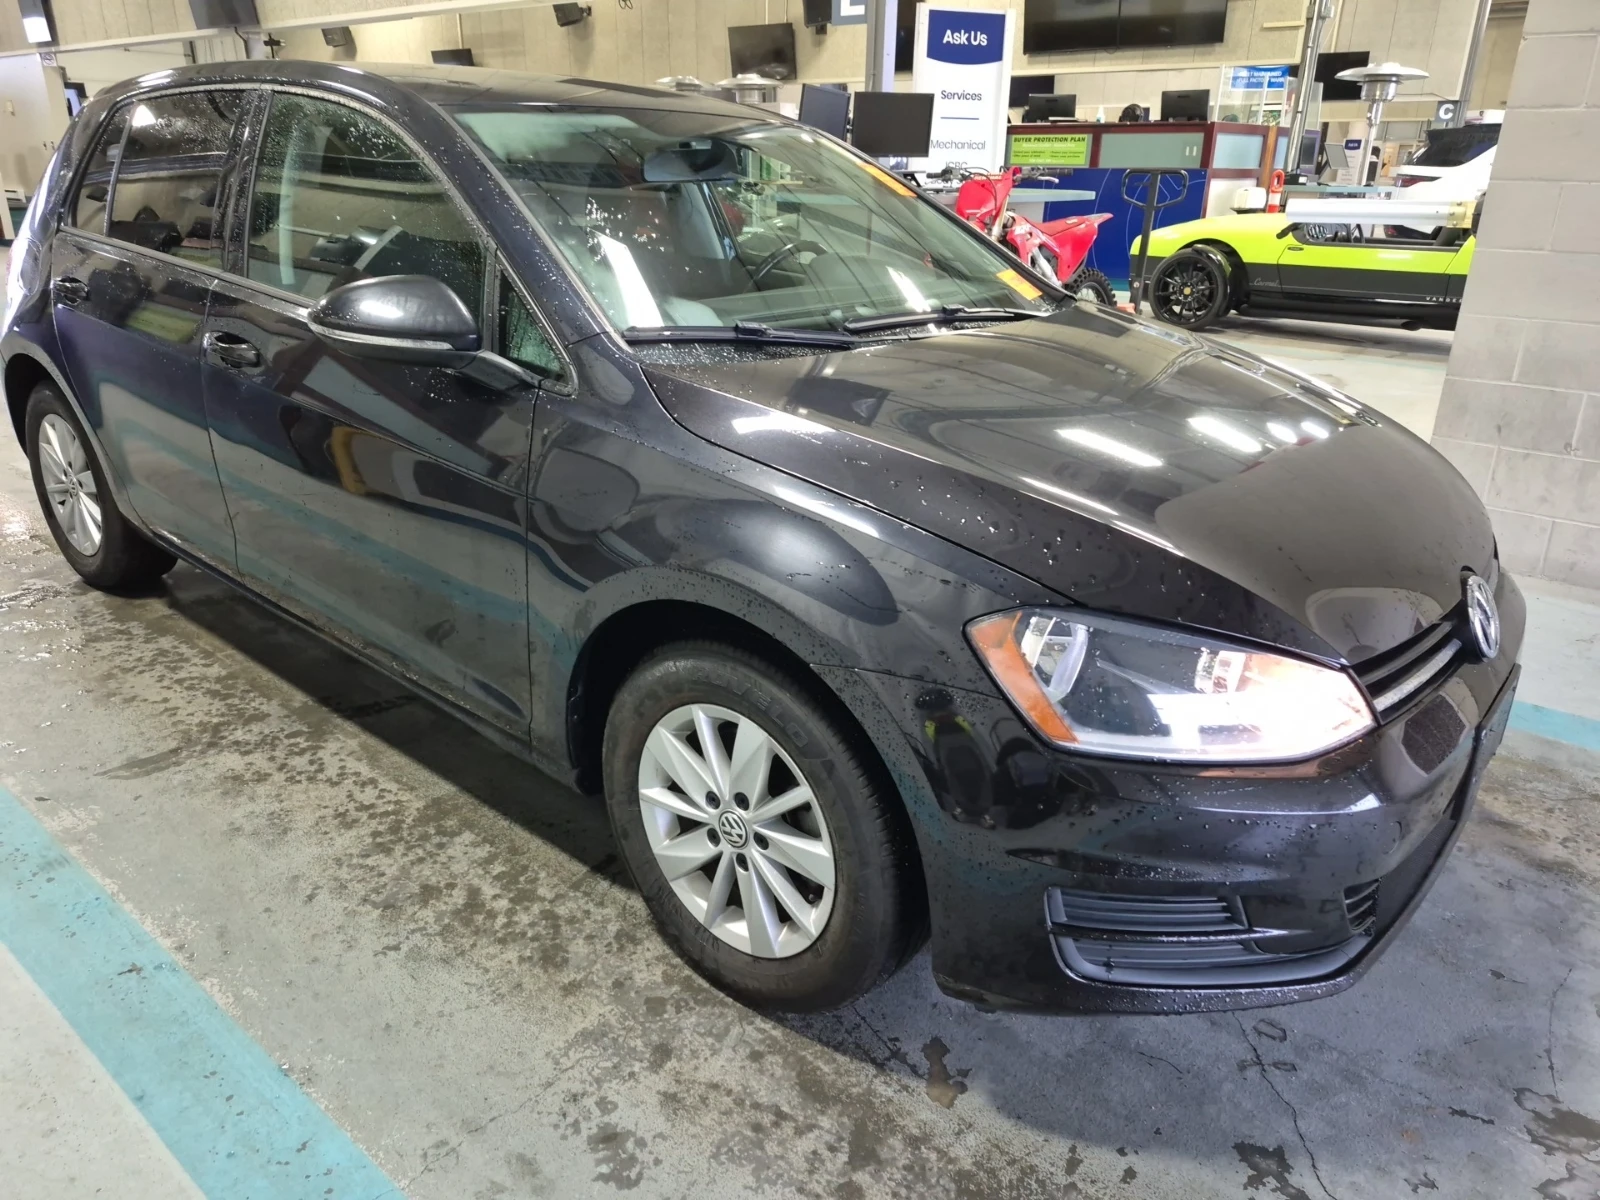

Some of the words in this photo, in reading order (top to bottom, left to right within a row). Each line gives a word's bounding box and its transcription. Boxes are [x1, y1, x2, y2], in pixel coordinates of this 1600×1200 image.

[943, 29, 968, 45] Ask
[970, 31, 988, 46] Us
[941, 90, 982, 101] Services
[1439, 103, 1455, 119] C
[930, 140, 986, 150] Mechanical
